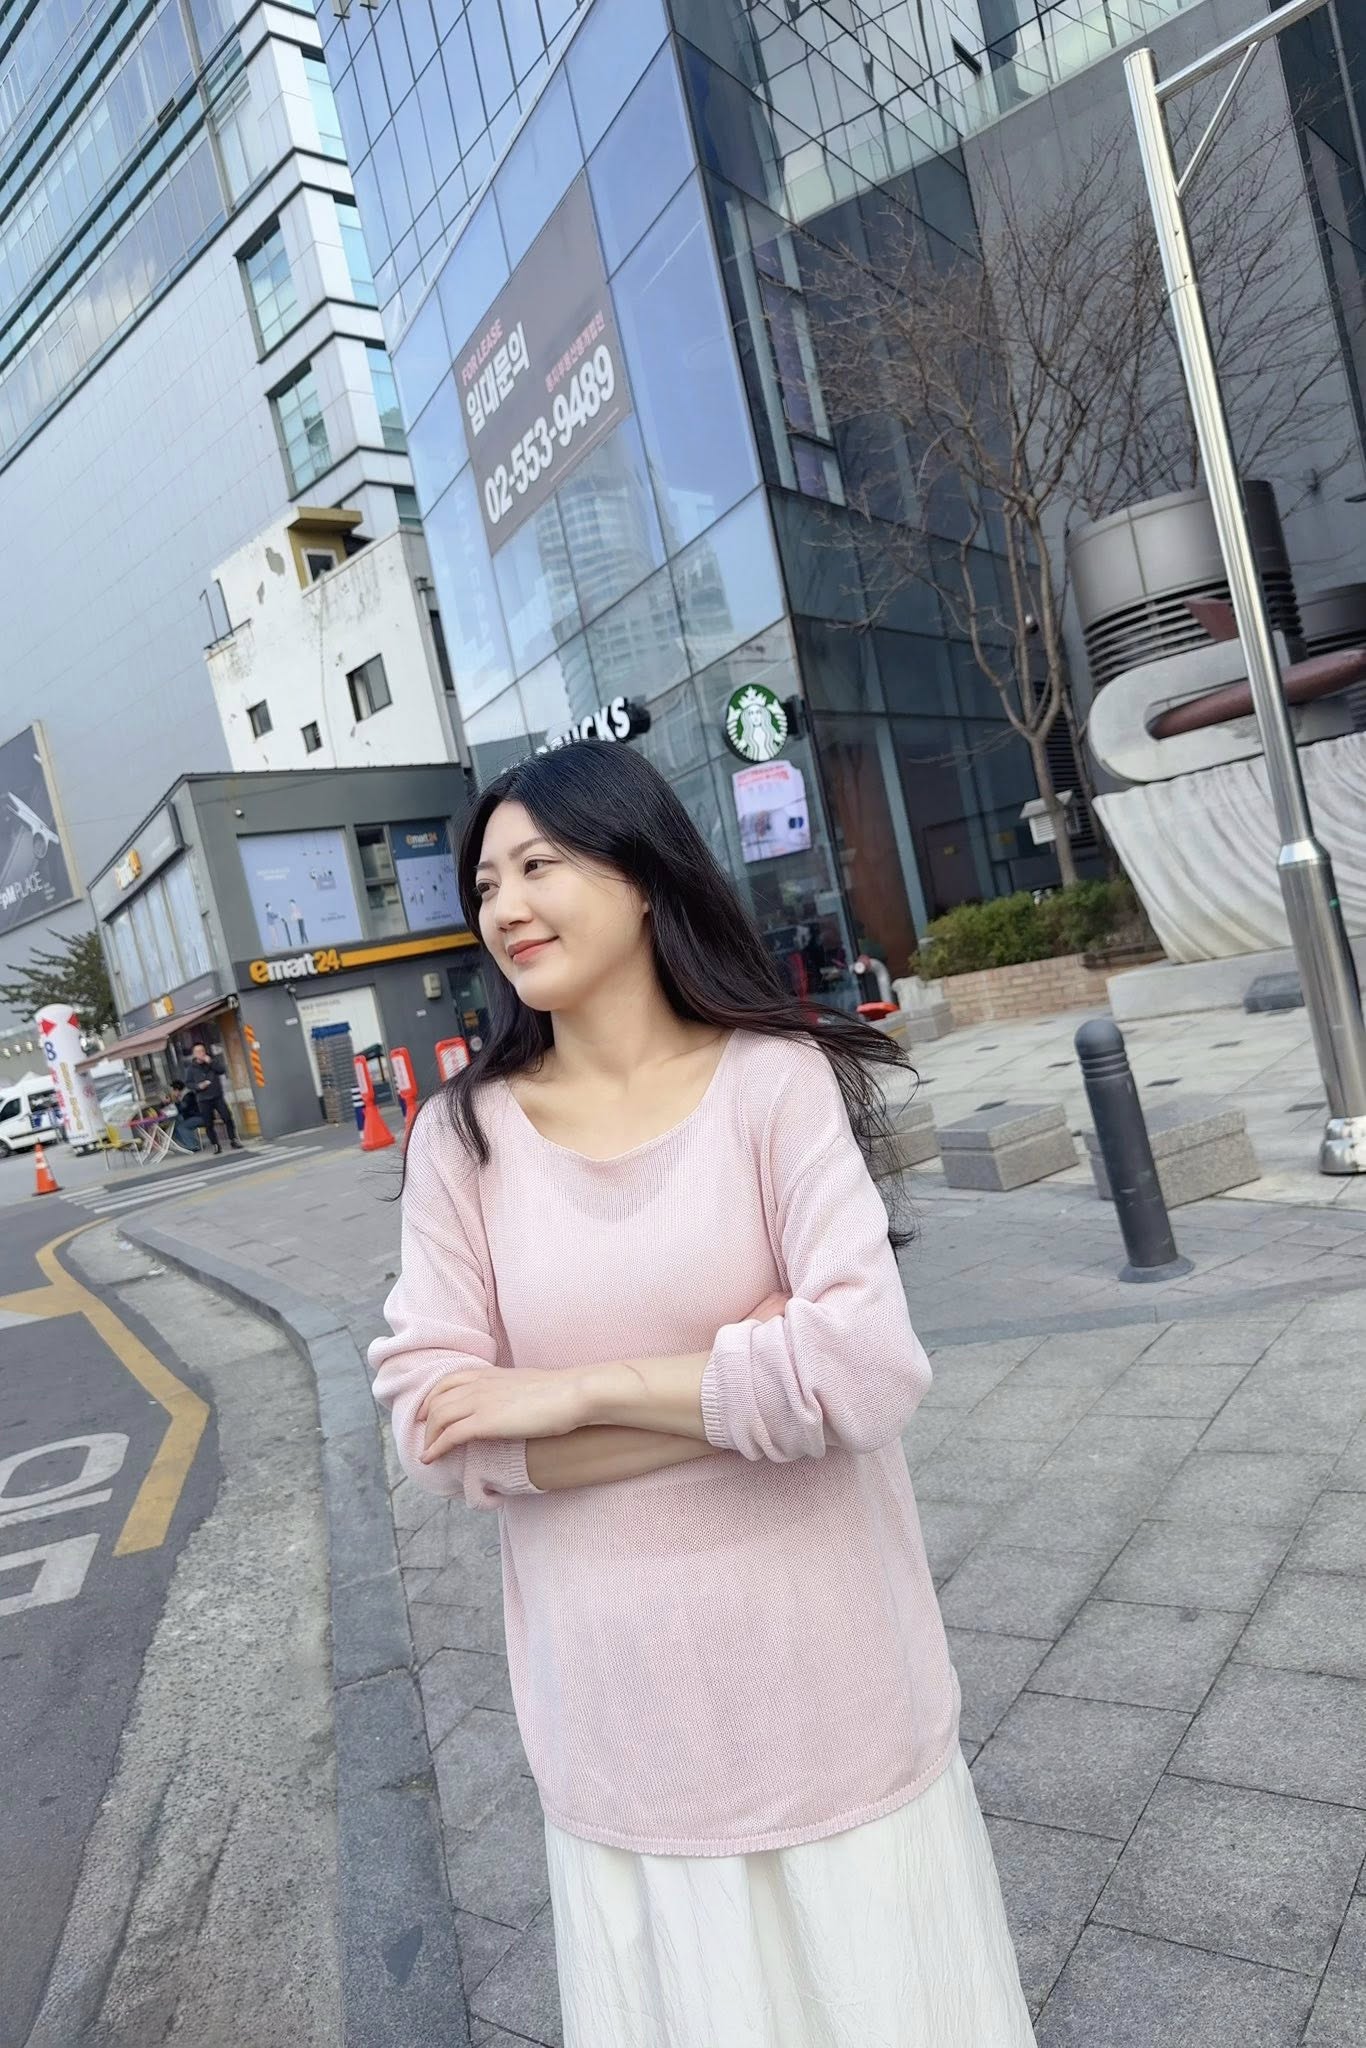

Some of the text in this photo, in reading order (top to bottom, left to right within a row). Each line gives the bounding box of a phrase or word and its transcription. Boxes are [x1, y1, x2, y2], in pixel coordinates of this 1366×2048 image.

[461, 317, 504, 386] FOR LEASE
[466, 320, 531, 437] 임대문의
[483, 343, 616, 525] 02-553-9489
[405, 832, 438, 846] emart24
[249, 948, 341, 984] emart24
